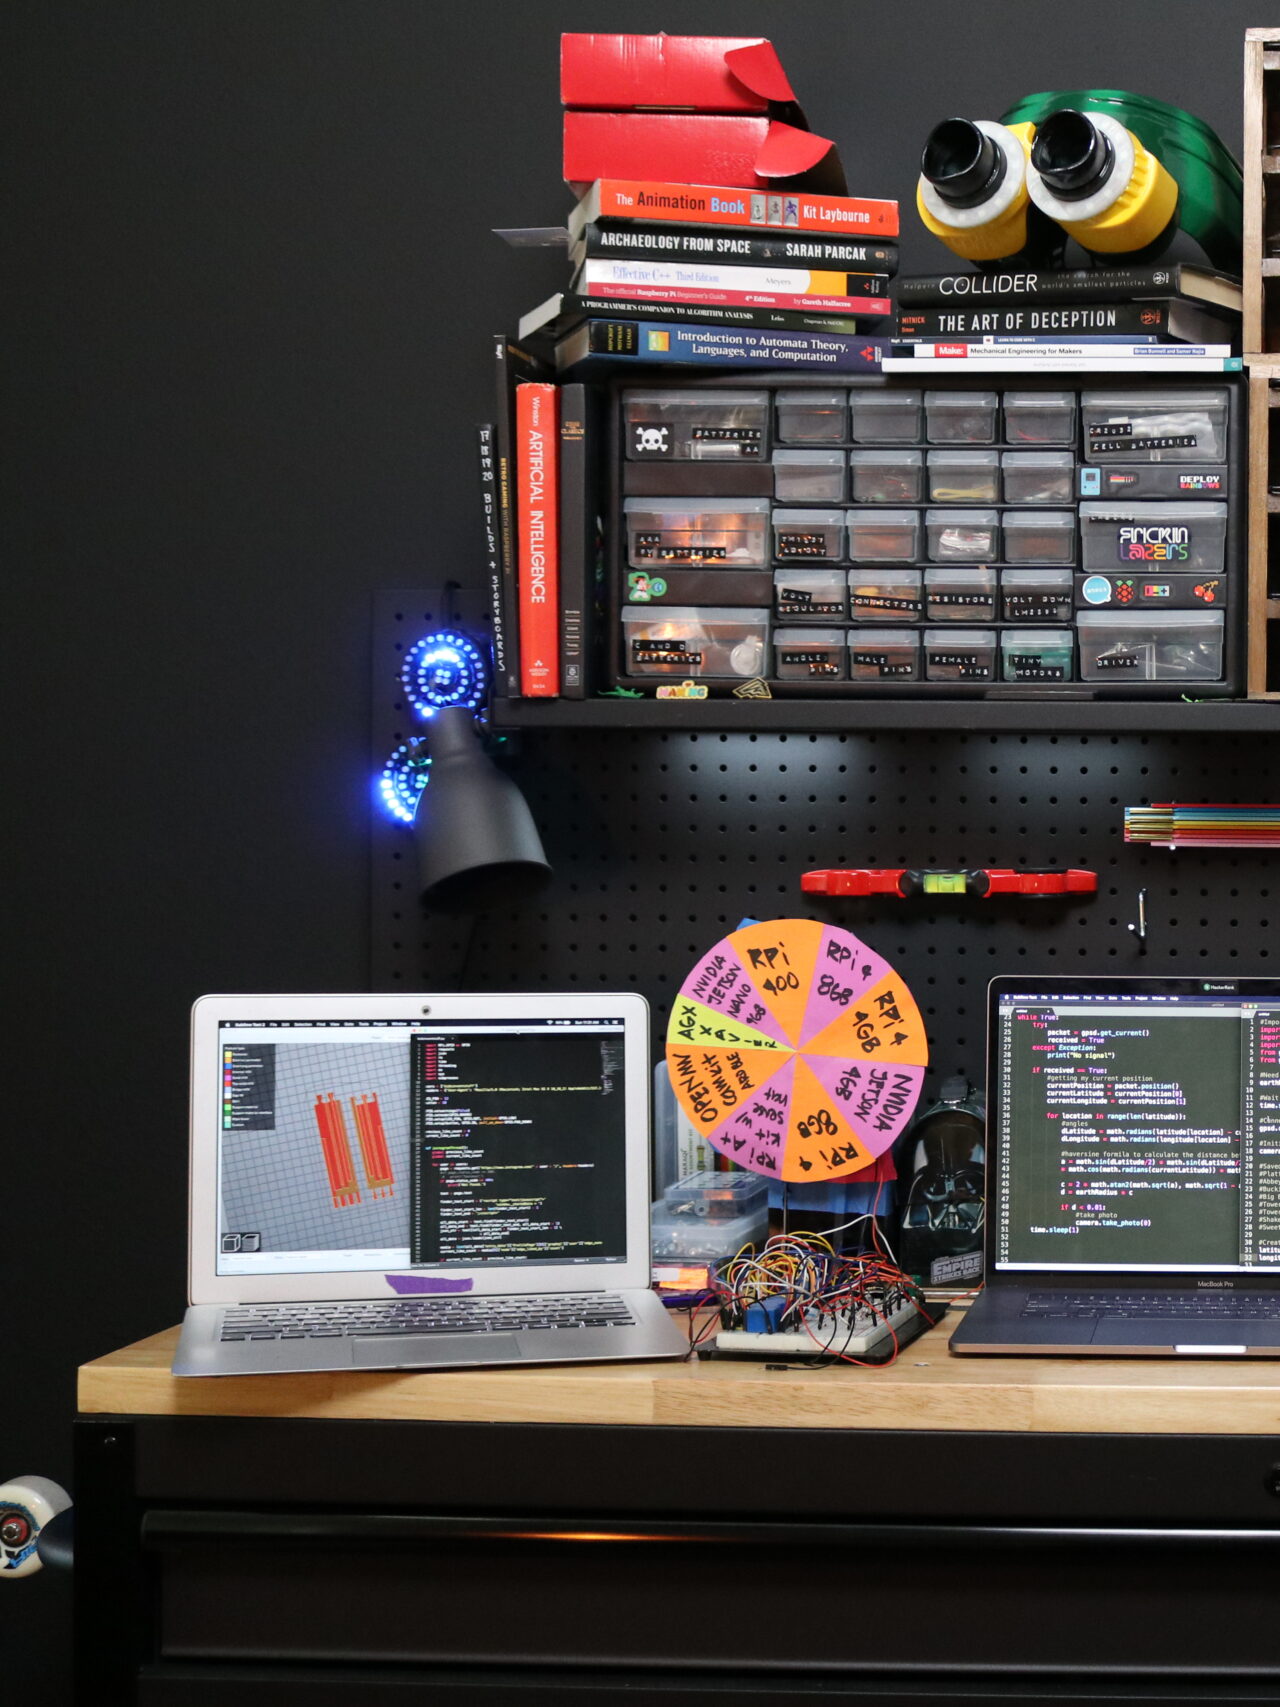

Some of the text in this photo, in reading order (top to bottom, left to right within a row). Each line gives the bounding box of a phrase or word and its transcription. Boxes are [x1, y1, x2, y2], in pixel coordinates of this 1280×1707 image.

[615, 191, 745, 214] The Animation Book
[803, 205, 870, 224] Kit Laybourne
[600, 232, 751, 254] ARCHAEOLOGY FROM SPACE
[786, 243, 866, 261] SARAH PARCAK
[613, 266, 719, 282] Effective C++ Third Edition
[637, 289, 668, 298] Raspberry
[939, 274, 1037, 295] COLLIDER
[638, 304, 675, 315] COMPANION
[938, 310, 1117, 332] THE ART OF DECEPTION
[677, 331, 849, 353] Introduction to Automata Theory,
[939, 347, 964, 355] Make:
[692, 343, 837, 362] Languages, and Computation
[1008, 348, 1047, 356] Engineering
[1180, 475, 1220, 483] DEPLOY
[529, 396, 546, 604] Winston ARTIFICIAL INTELLIGENCE
[692, 955, 727, 998] NVIDIA
[678, 1006, 697, 1040] AGX
[933, 1258, 980, 1276] EMPIRE
